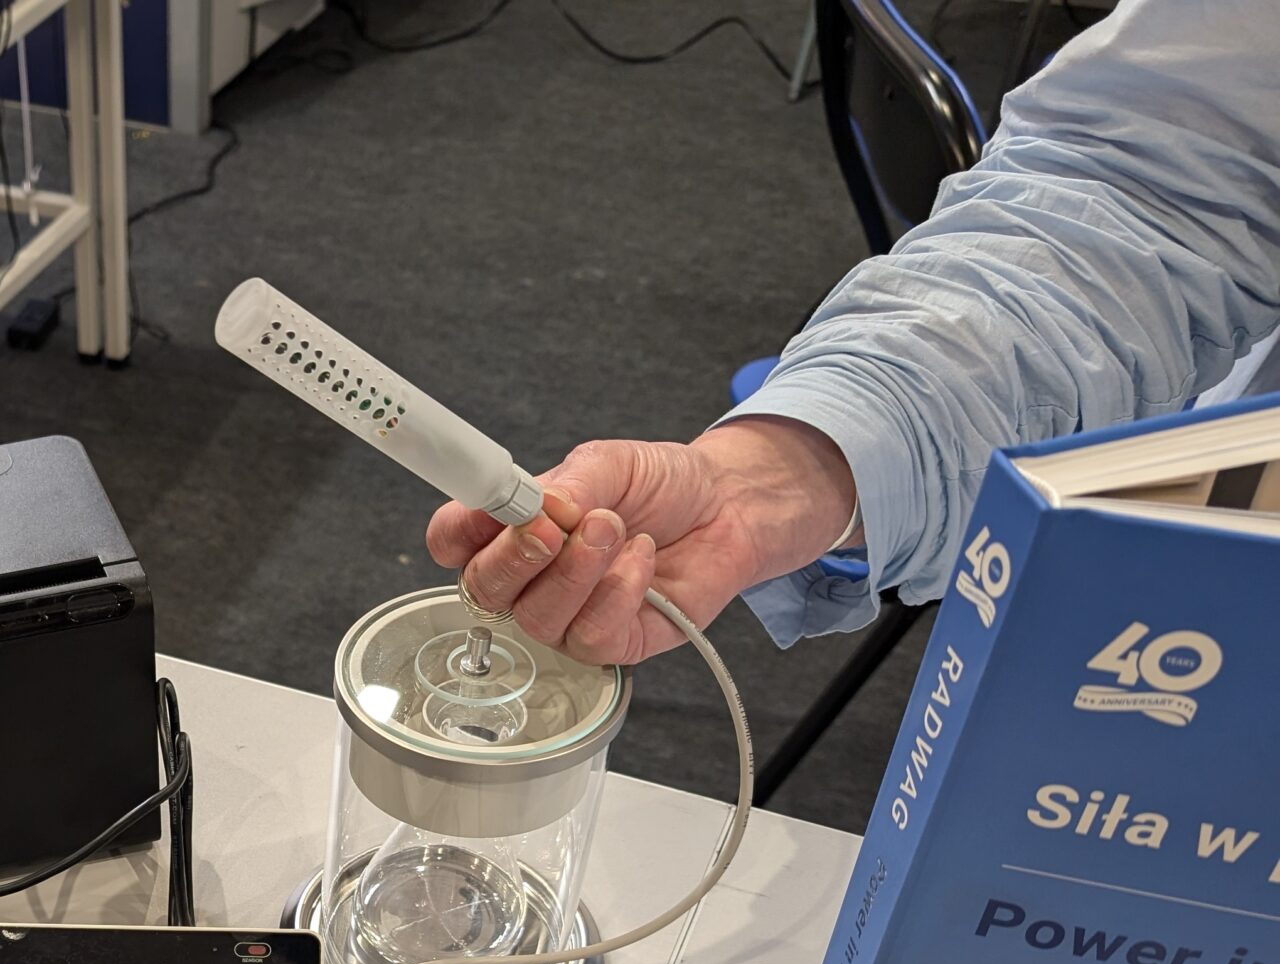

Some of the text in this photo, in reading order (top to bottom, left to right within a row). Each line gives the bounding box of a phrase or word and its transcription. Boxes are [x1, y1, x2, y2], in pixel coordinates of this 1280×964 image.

[1086, 621, 1223, 692] 40
[891, 644, 966, 831] RADWAG
[1098, 697, 1175, 707] ANNIVERSARY
[1027, 783, 1260, 864] Siła w
[855, 857, 888, 939] Power
[844, 935, 860, 964] in
